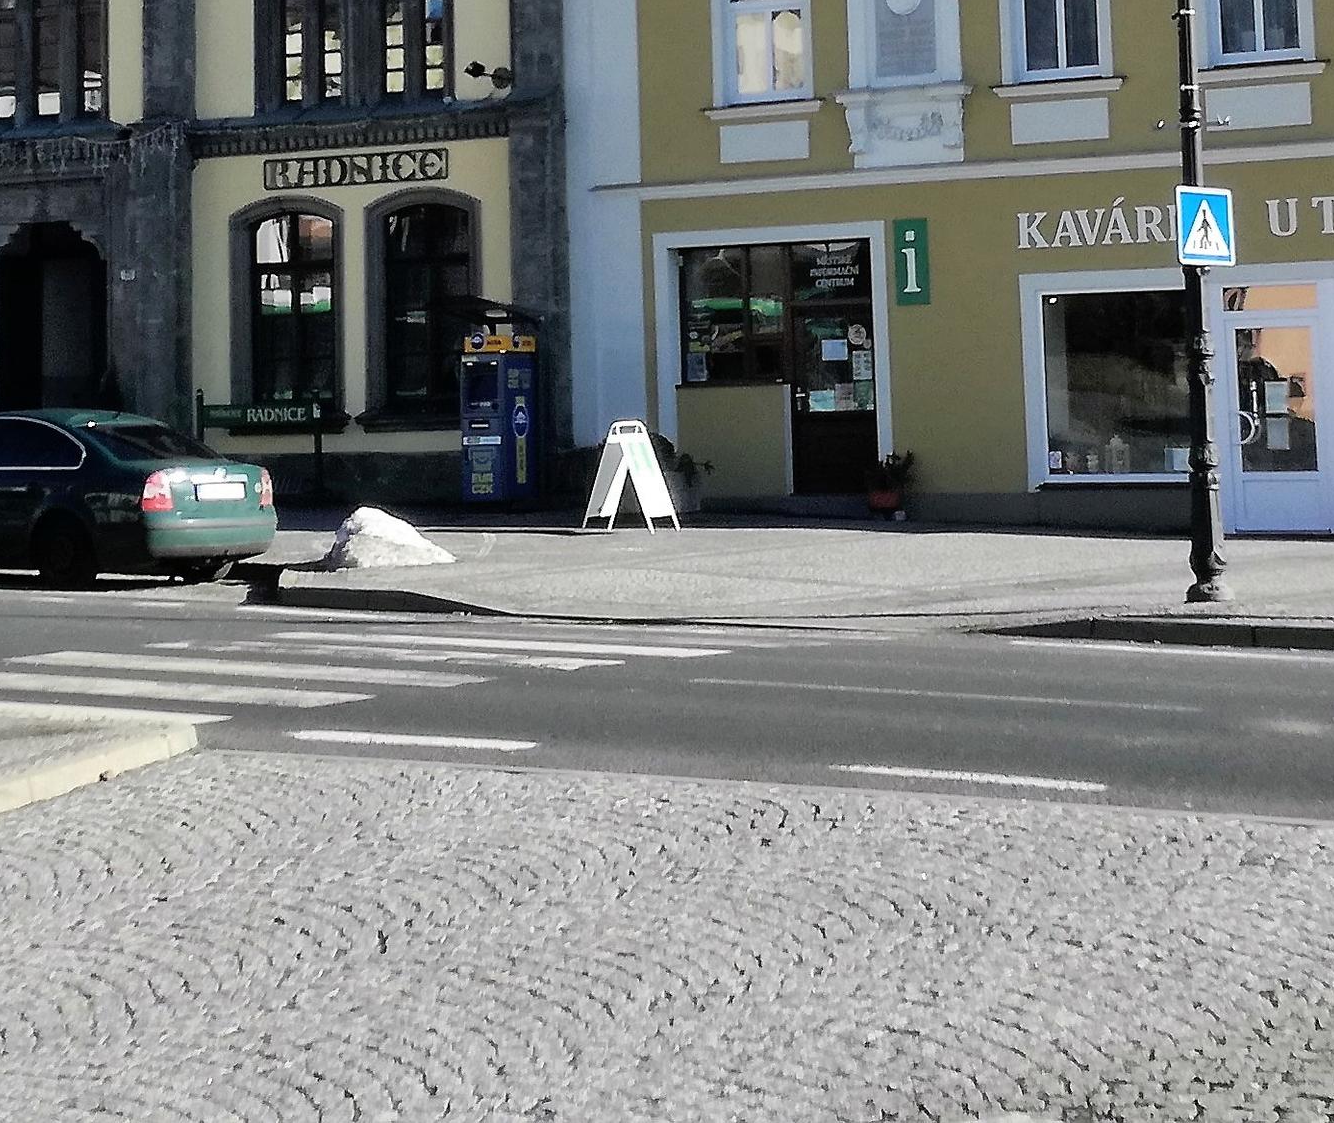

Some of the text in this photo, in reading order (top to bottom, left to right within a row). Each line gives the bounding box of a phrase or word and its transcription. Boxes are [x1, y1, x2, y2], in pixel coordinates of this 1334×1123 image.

[270, 150, 446, 189] RADNICE
[1017, 196, 1177, 249] KAVÁR
[1265, 198, 1301, 238] U
[246, 406, 307, 423] RADNICE
